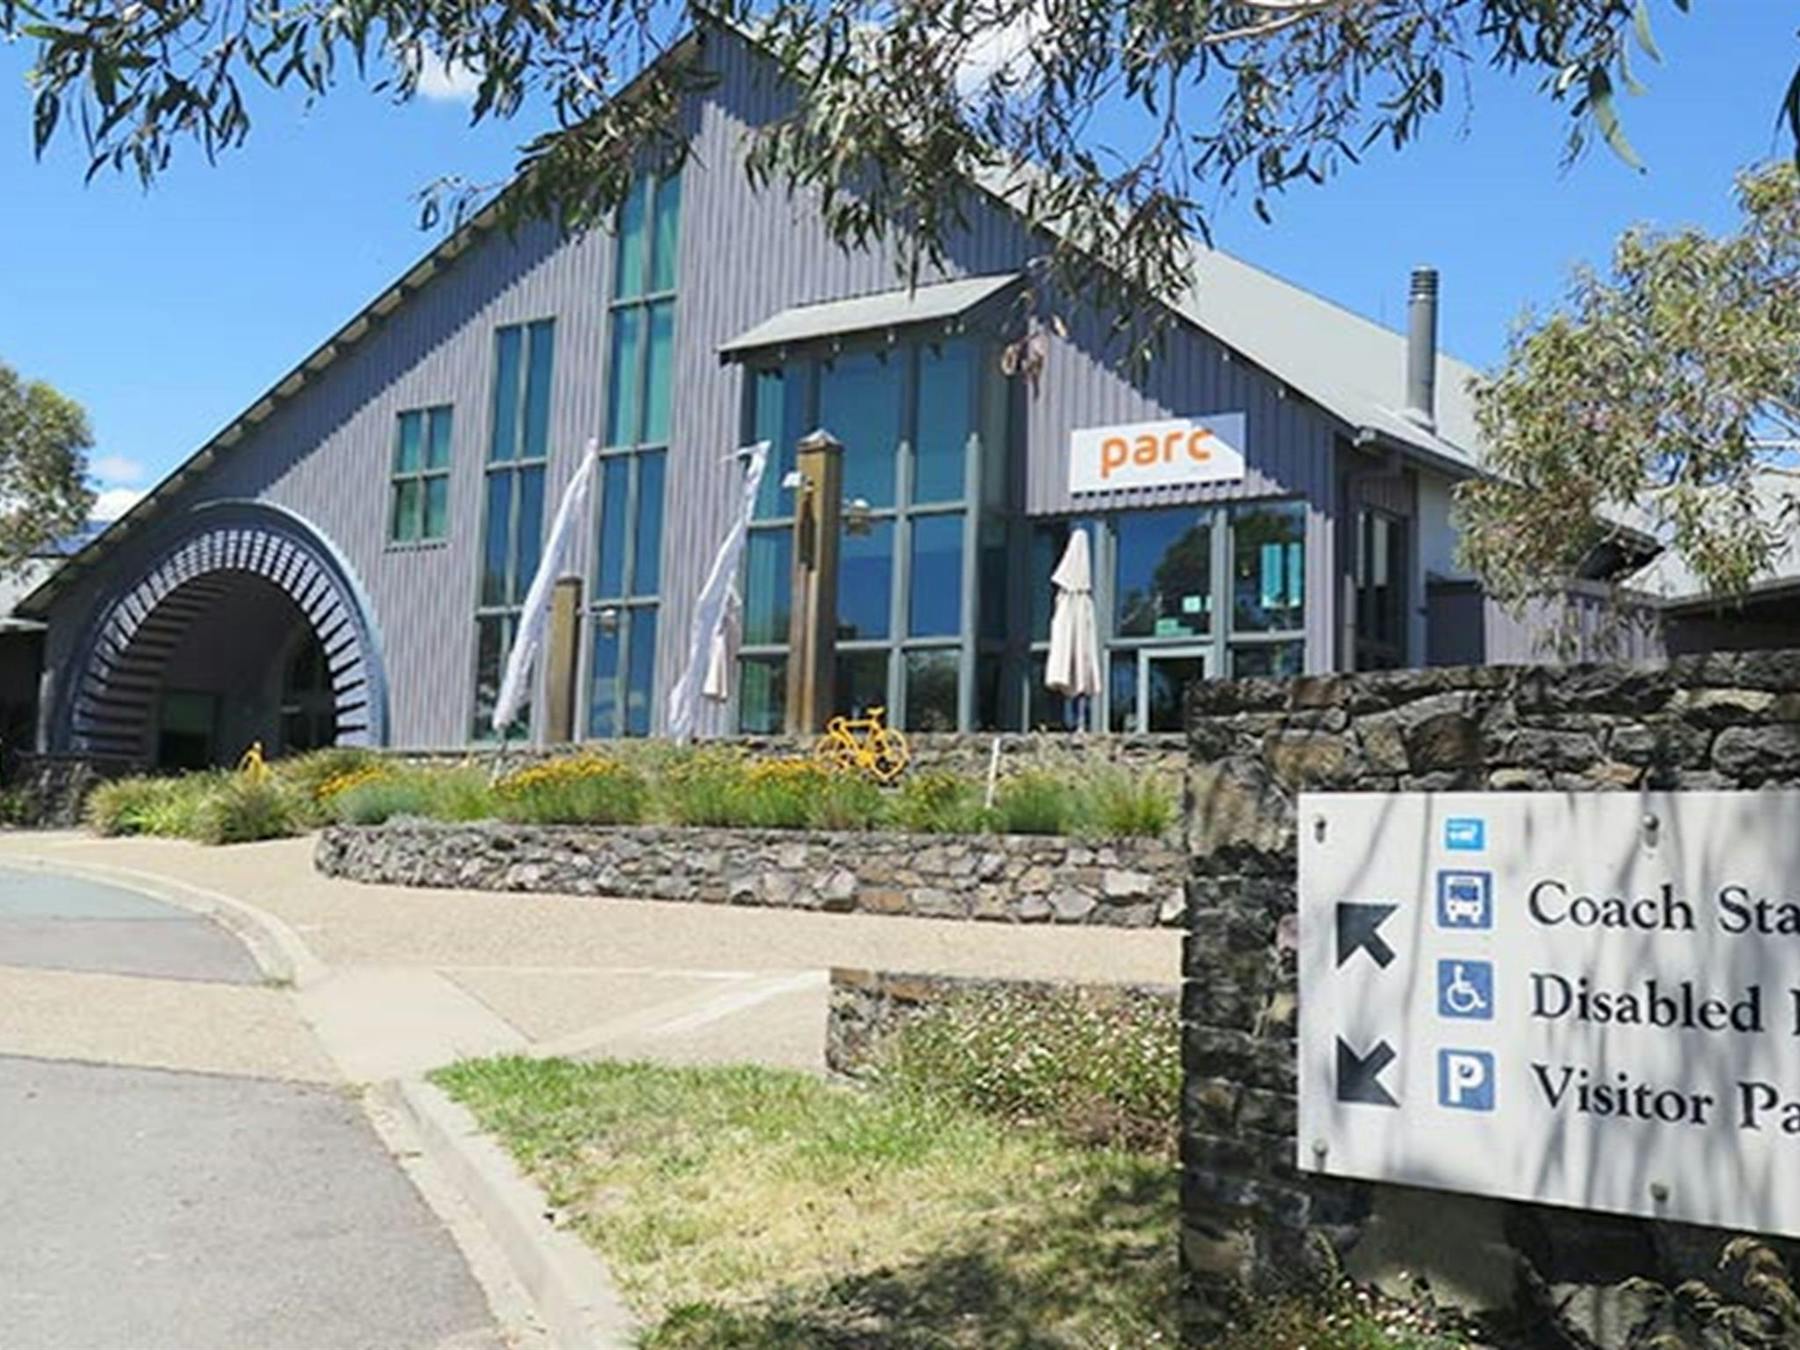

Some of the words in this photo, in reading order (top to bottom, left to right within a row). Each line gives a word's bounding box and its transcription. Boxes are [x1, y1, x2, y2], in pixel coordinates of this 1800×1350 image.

[1101, 427, 1213, 478] parc
[1528, 880, 1695, 930] Coach
[1719, 886, 1800, 935] Sta
[1532, 973, 1764, 1032] Disabled
[1448, 1055, 1484, 1102] P
[1532, 1064, 1713, 1126] Visitor
[1737, 1081, 1800, 1134] Pa
